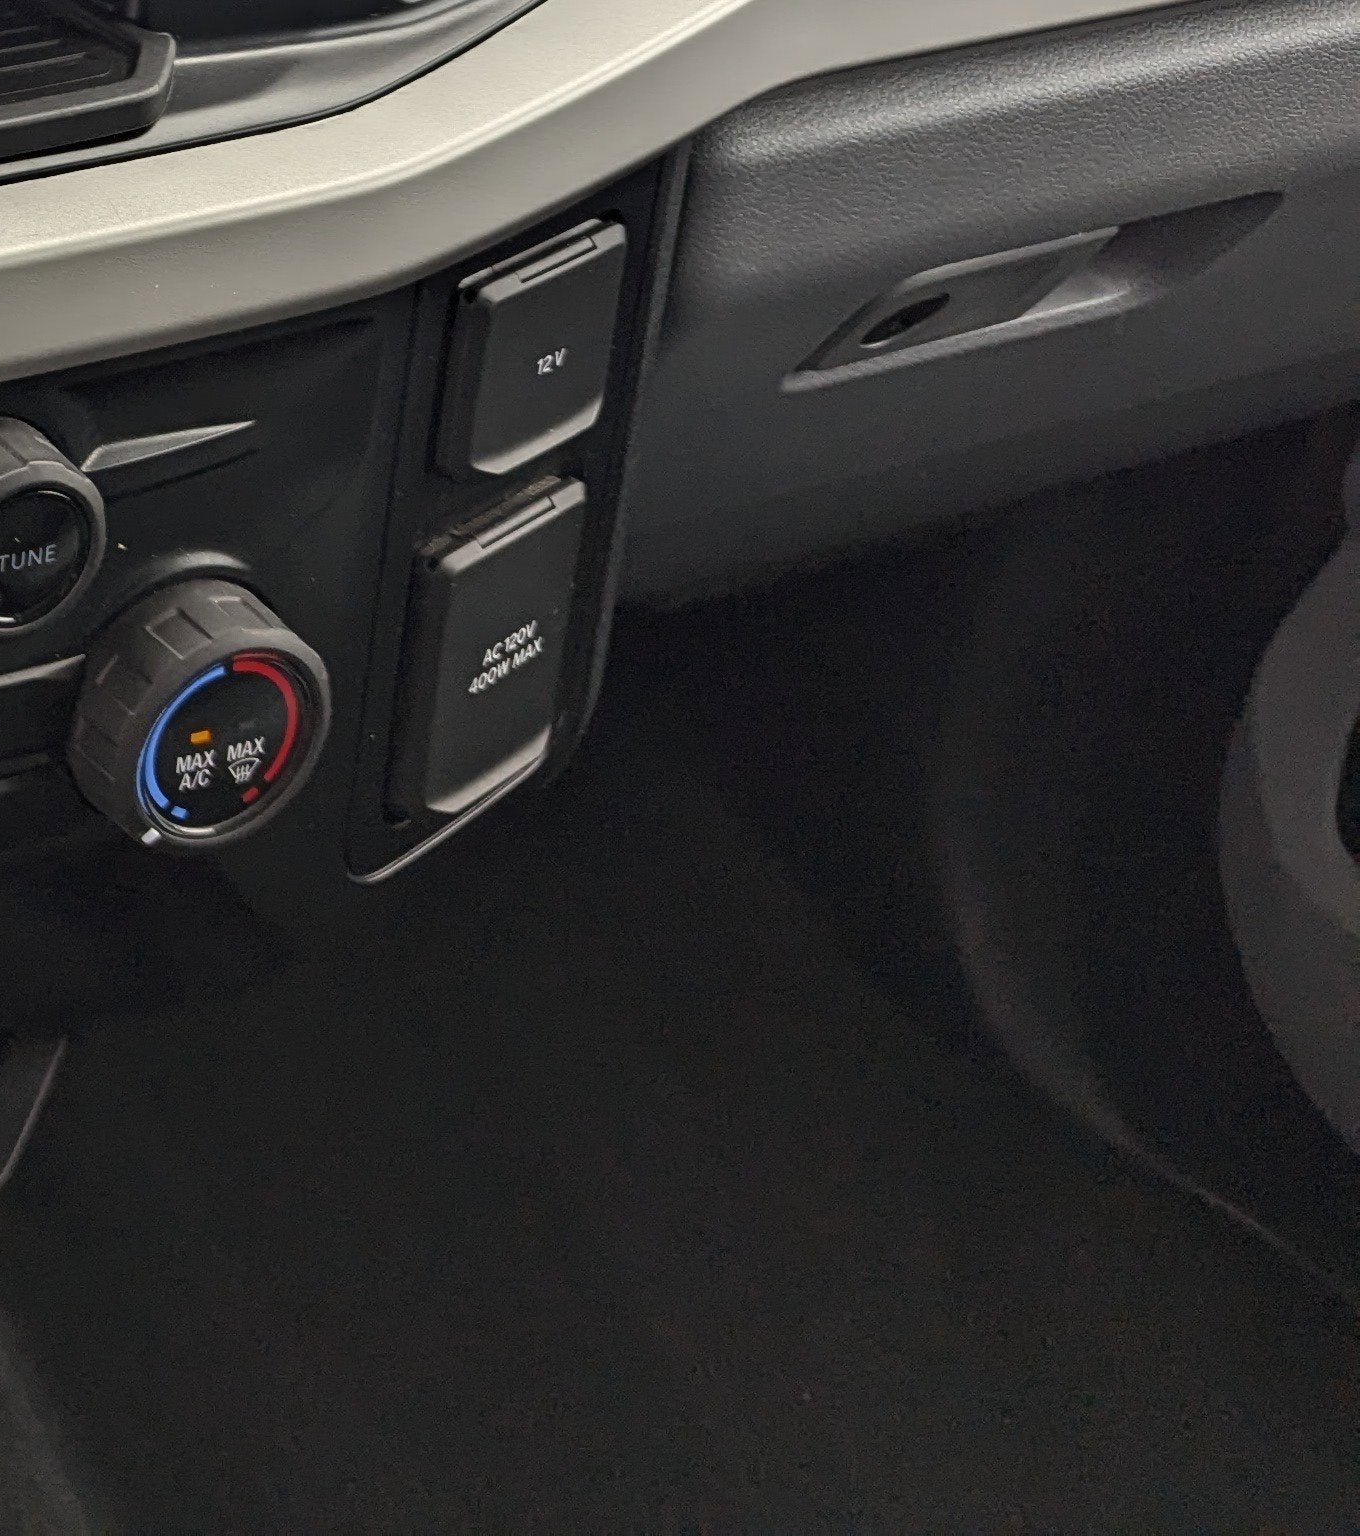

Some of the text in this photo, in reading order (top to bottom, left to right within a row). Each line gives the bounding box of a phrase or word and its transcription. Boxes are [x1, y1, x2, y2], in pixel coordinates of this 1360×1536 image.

[468, 635, 543, 694] 400W MAX
[482, 641, 503, 667] AC
[175, 749, 216, 774] MAX
[226, 736, 265, 762] MAX
[178, 768, 213, 791] A/C
